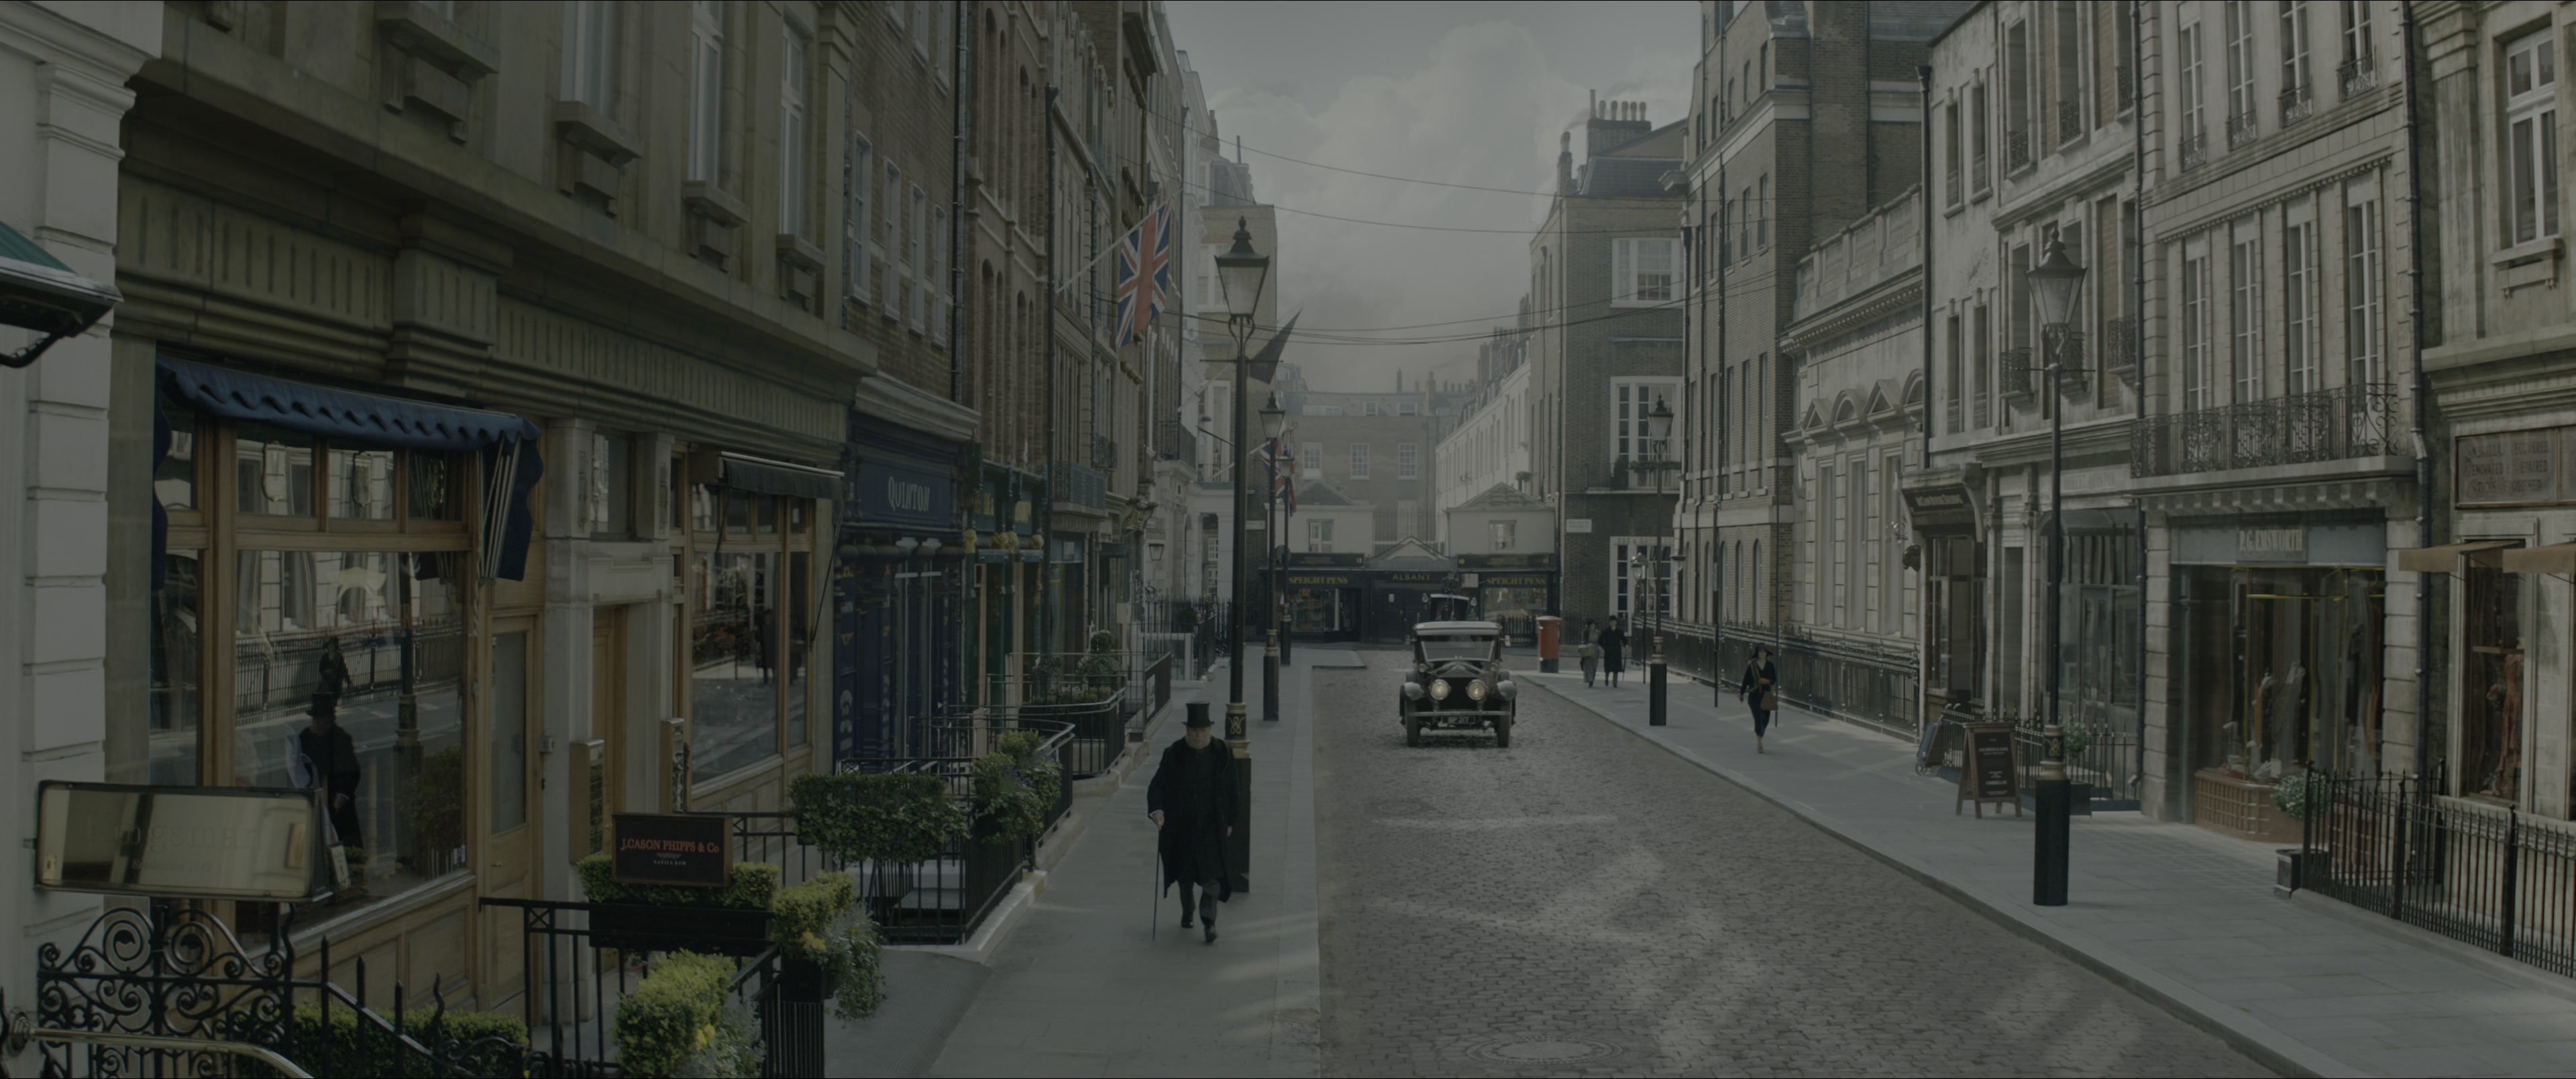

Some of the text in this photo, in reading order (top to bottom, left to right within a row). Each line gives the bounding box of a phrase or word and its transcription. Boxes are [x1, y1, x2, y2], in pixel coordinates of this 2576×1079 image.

[888, 476, 930, 512] QUINTON
[1326, 576, 1348, 584] PENS
[1524, 577, 1546, 585] PENS
[663, 839, 696, 852] PHIPPS
[698, 841, 705, 853] &
[707, 842, 720, 854] Co
